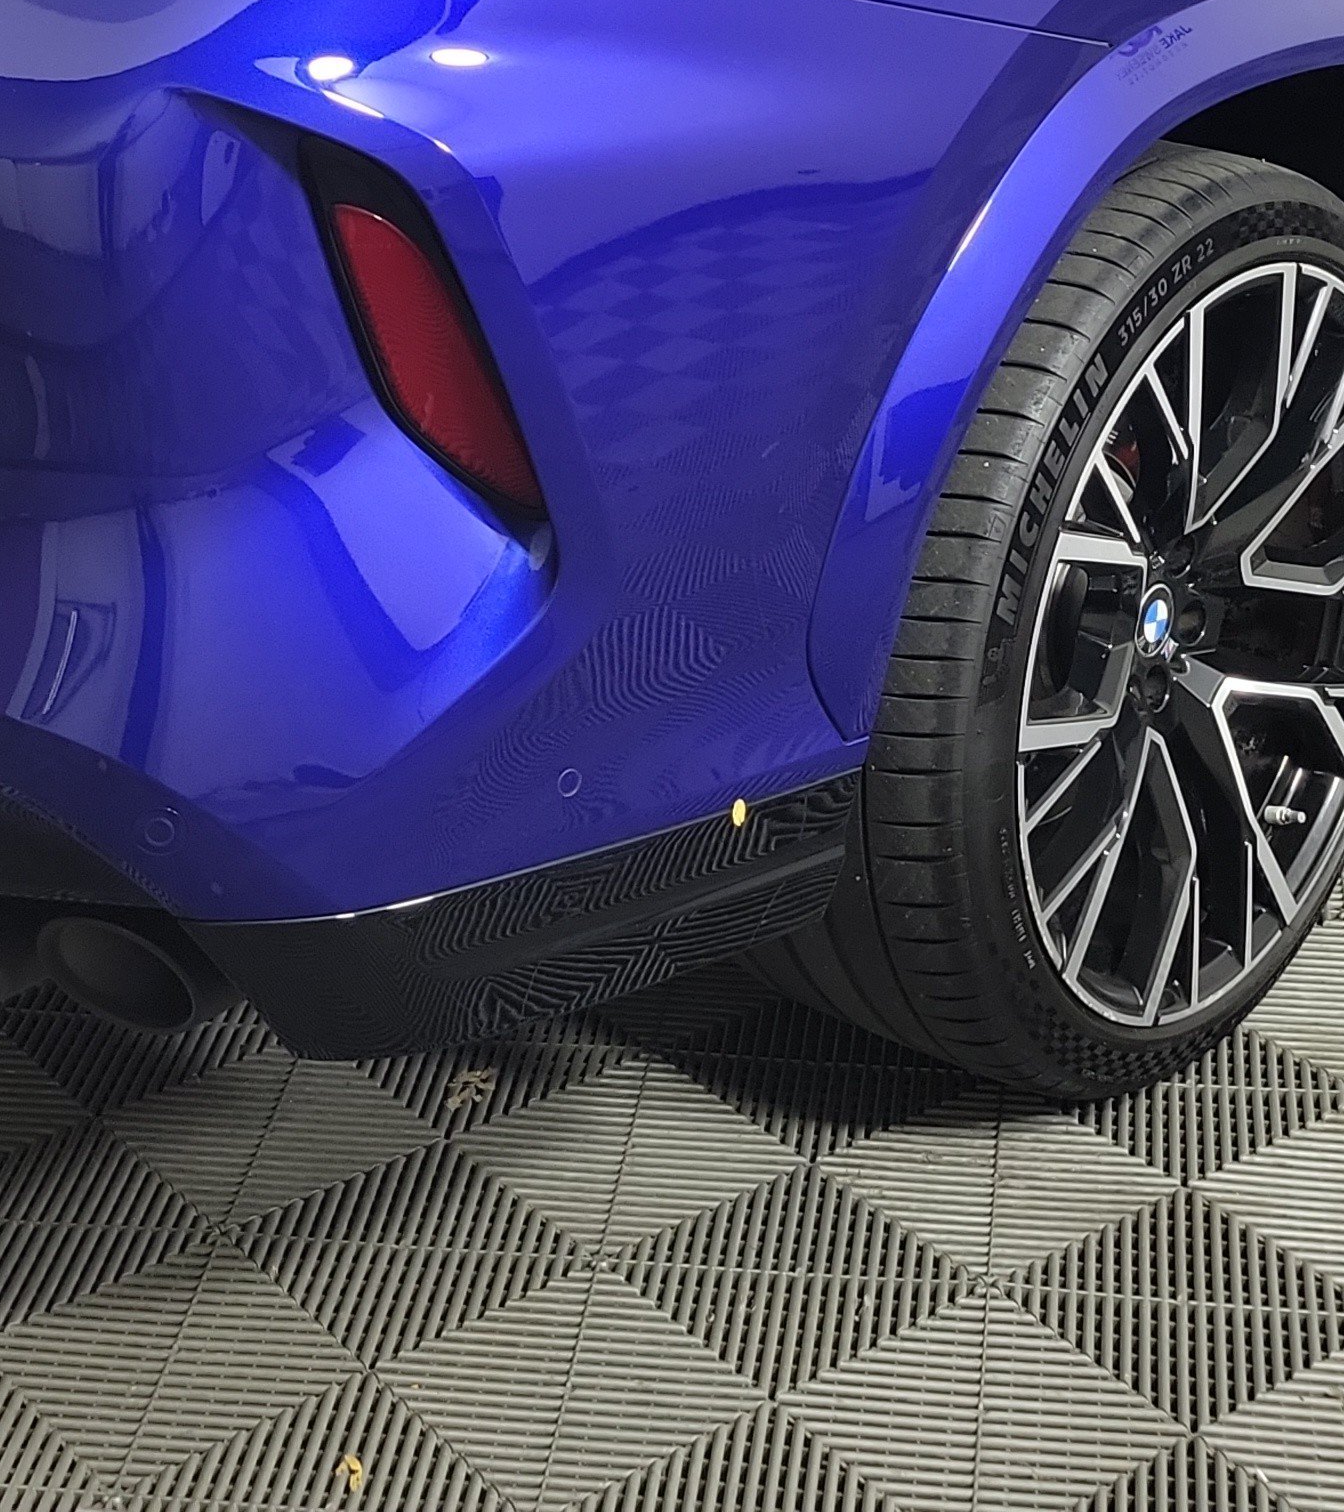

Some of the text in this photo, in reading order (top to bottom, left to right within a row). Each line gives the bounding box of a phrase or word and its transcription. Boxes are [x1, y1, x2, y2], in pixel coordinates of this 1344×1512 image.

[1118, 237, 1214, 347] 315/30 ZR 22
[996, 352, 1108, 627] MICHELIN
